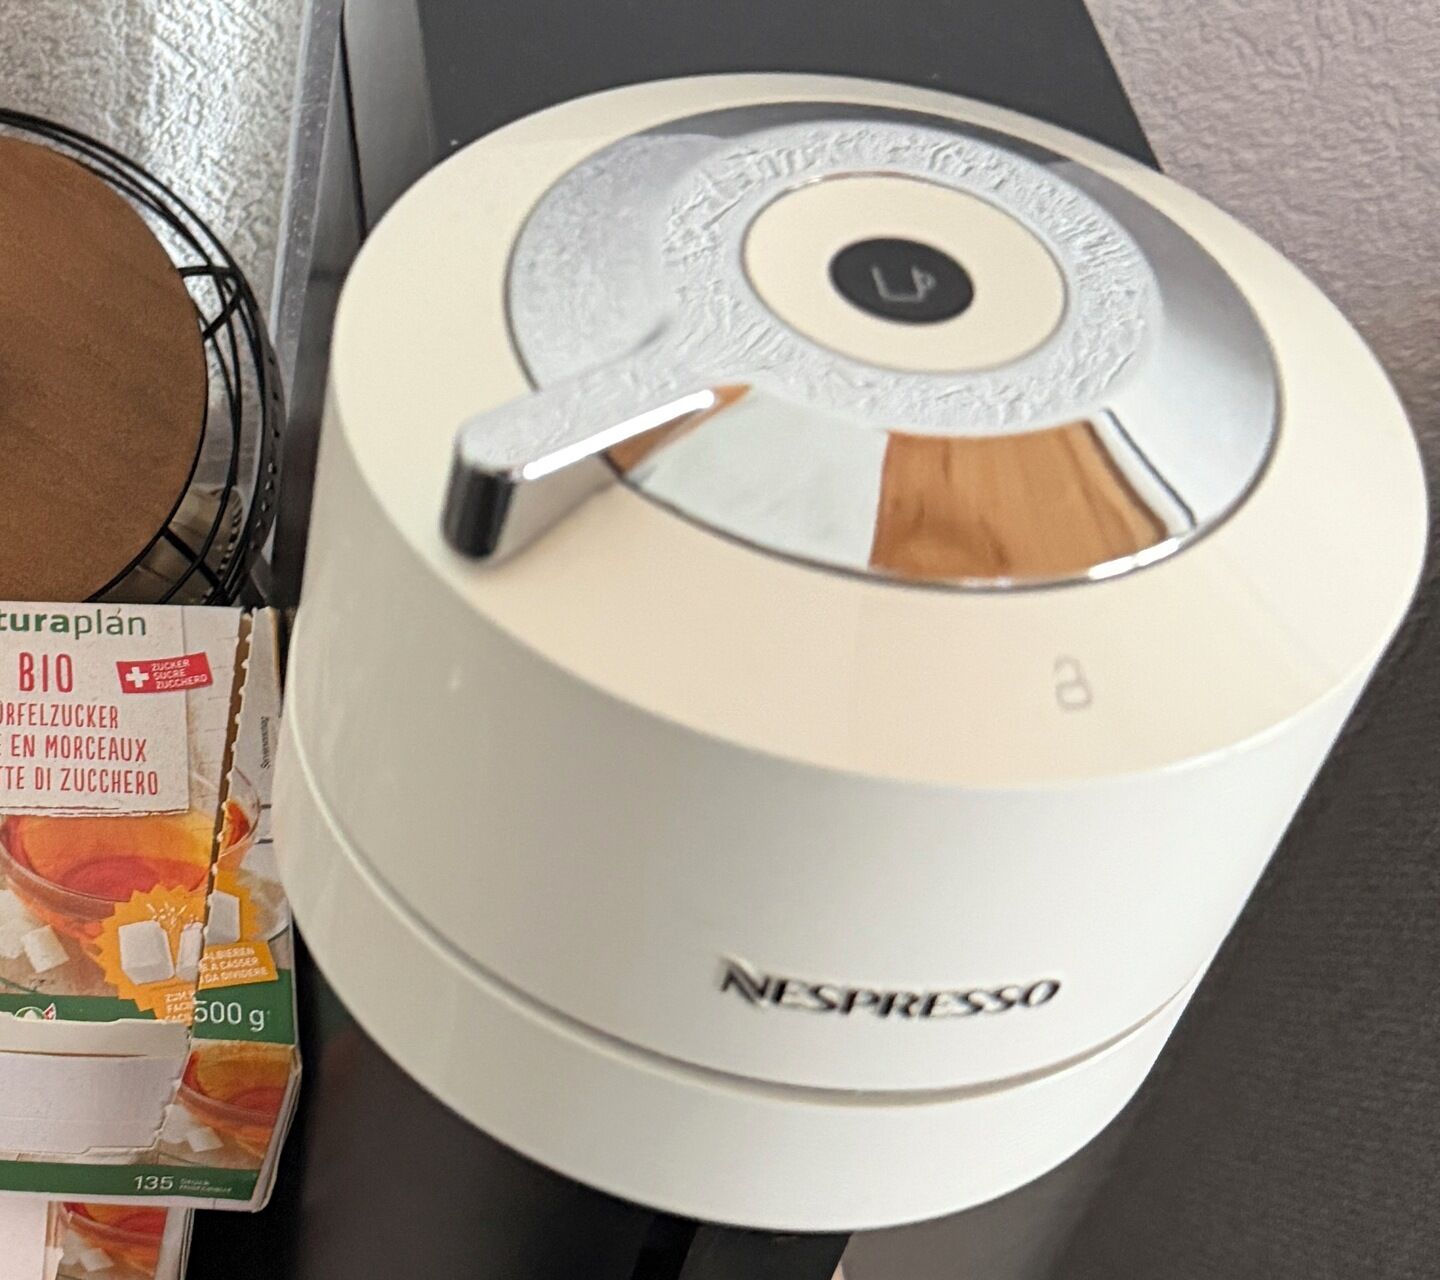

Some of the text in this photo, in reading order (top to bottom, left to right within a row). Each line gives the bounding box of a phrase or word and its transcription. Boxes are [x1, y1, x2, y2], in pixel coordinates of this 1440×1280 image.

[18, 651, 74, 694] BIO
[10, 733, 36, 758] EN
[44, 736, 147, 763] MORCEAUX
[34, 766, 51, 791] DI
[60, 768, 158, 795] ZUCCHERO
[717, 958, 1062, 1020] NESPRESSO
[249, 1008, 266, 1033] g
[133, 1175, 174, 1191] 135
